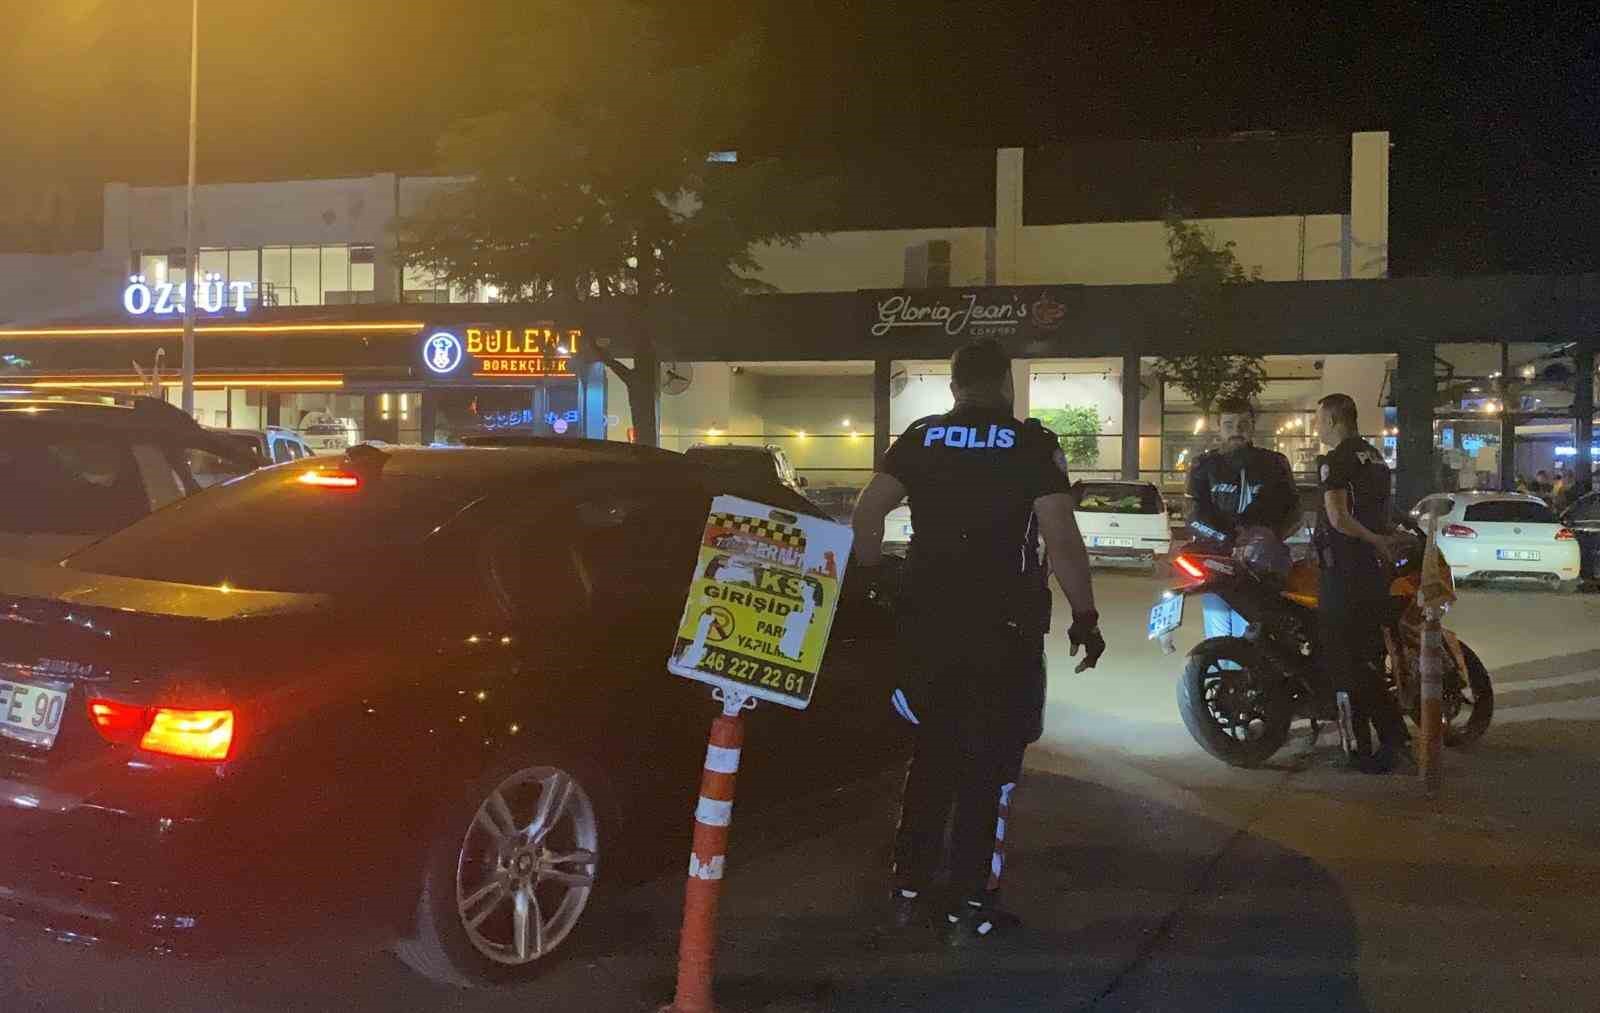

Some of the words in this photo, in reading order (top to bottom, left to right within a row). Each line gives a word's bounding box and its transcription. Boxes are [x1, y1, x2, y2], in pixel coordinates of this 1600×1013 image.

[871, 295, 950, 336] Gloria
[945, 294, 1027, 335] Jean's
[923, 424, 1015, 448] POLİS
[757, 621, 787, 638] PAR
[703, 651, 726, 672] 46
[728, 657, 760, 680] 227
[760, 666, 782, 687] 22
[785, 673, 804, 693] 61
[32, 692, 63, 729] 90
